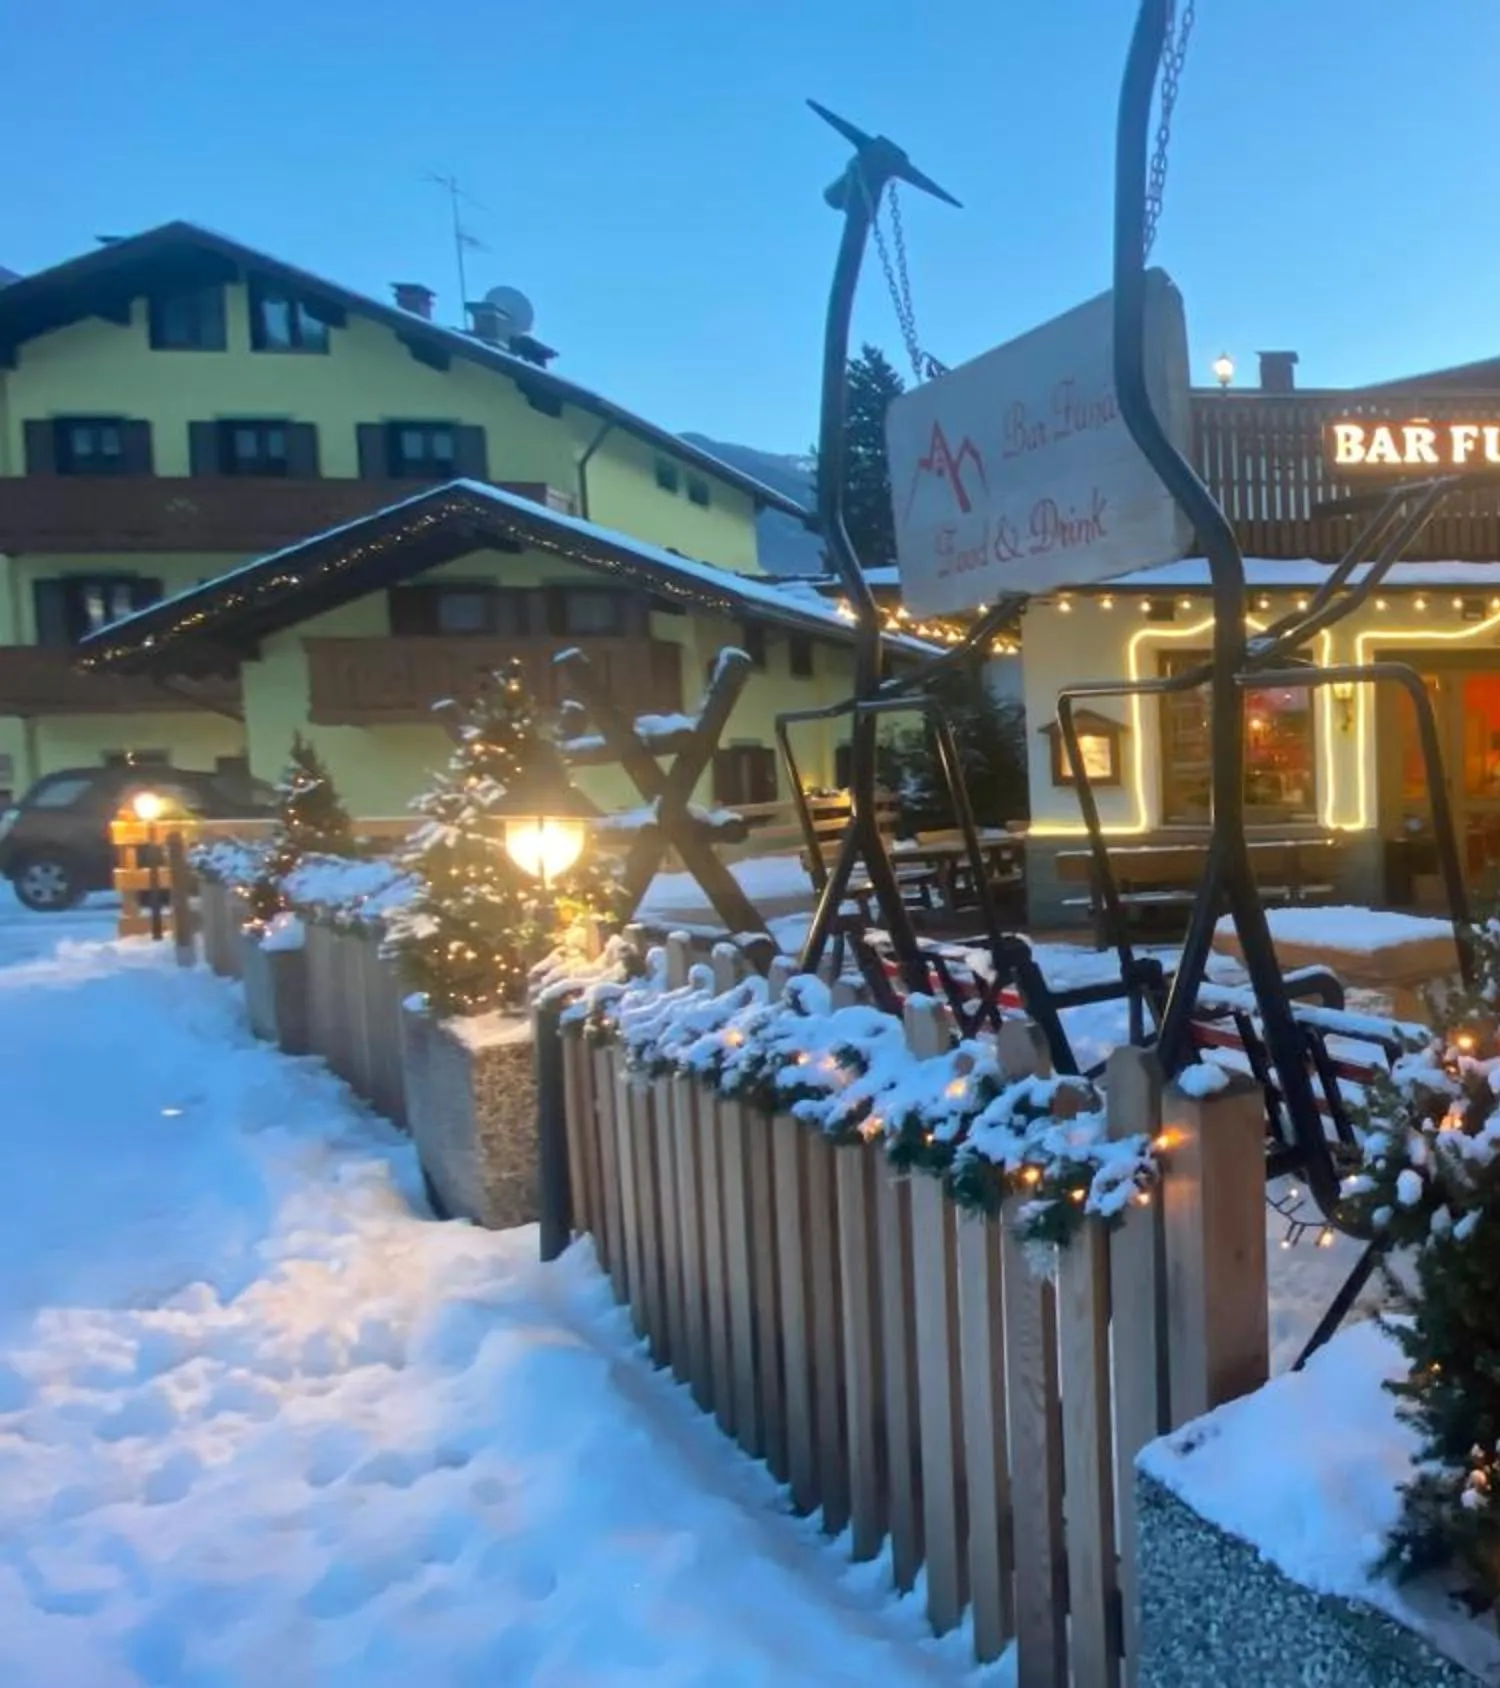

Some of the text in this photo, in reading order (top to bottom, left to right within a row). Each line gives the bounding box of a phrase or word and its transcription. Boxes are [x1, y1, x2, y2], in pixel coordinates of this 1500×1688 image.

[1002, 400, 1047, 460] Bar
[1333, 423, 1439, 464] BAR
[934, 486, 1107, 578] Food & Drink
